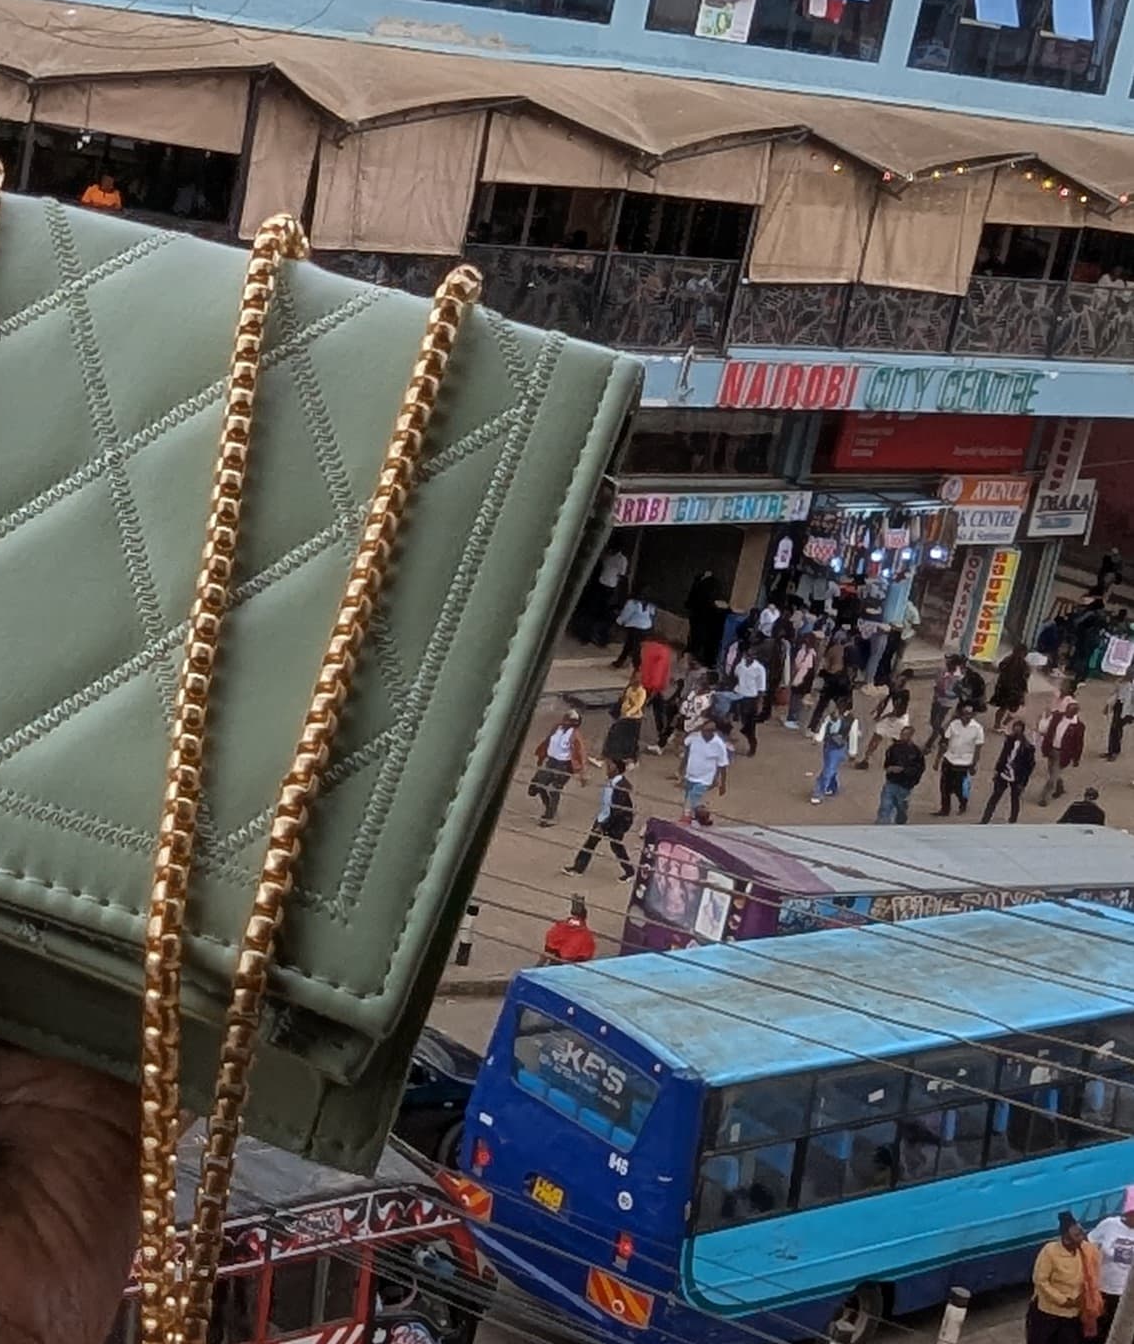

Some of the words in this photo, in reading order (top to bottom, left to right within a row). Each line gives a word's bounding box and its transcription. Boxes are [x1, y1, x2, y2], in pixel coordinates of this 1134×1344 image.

[720, 361, 860, 408] NAIROBI
[864, 367, 938, 410] CITY
[936, 368, 1046, 413] CENTRE
